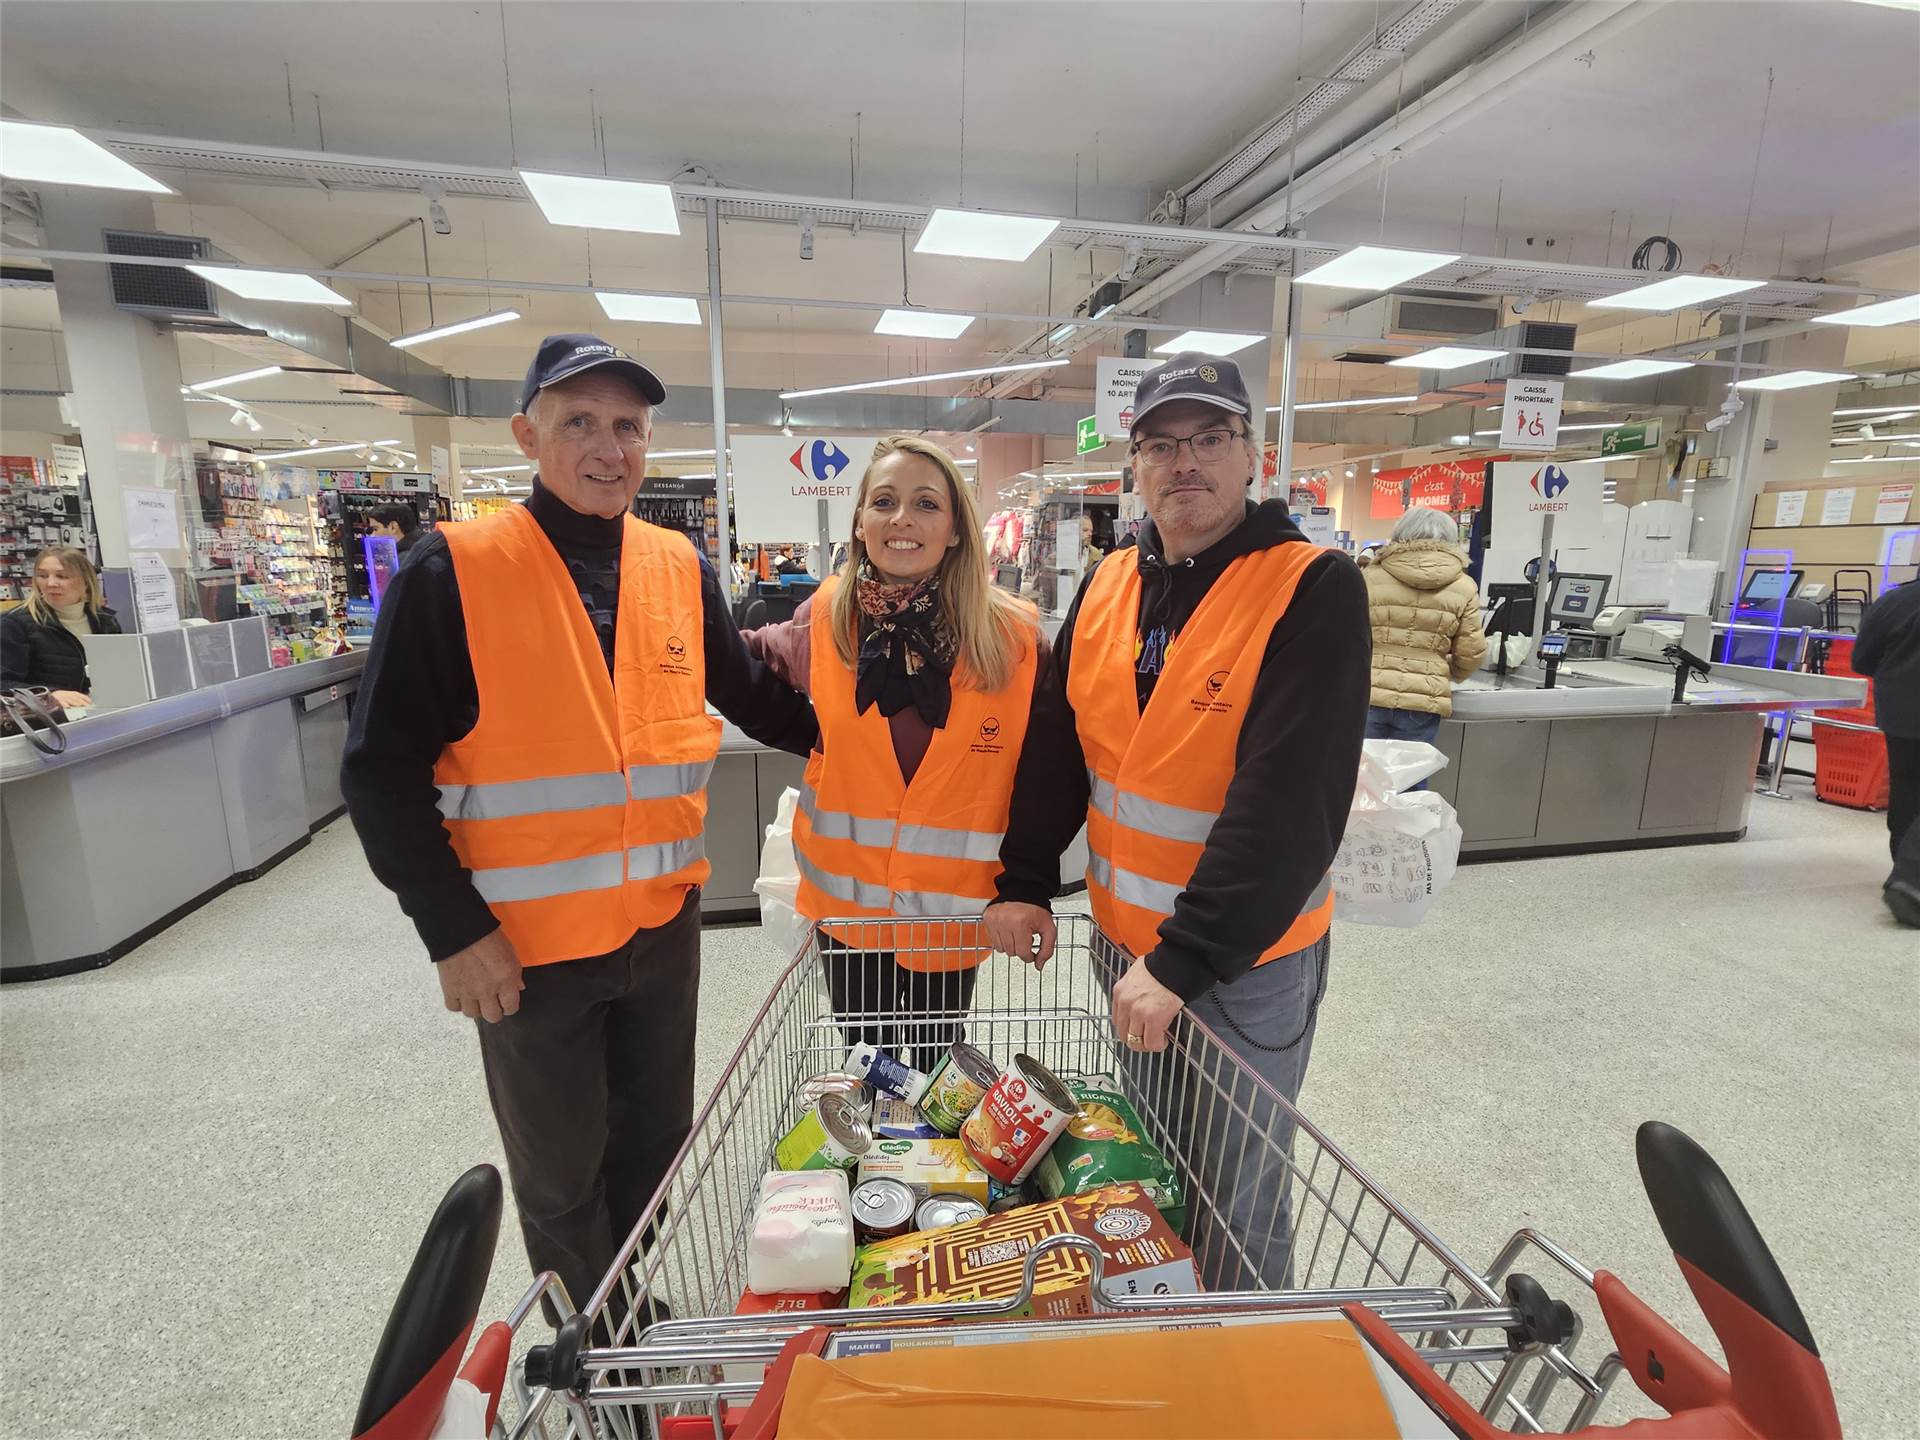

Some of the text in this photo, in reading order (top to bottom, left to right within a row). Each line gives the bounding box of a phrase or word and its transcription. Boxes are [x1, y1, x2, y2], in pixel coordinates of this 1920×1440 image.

[575, 345, 614, 355] Rotary
[1158, 366, 1197, 383] Rotary
[1107, 390, 1136, 398] 10 ARTI
[1523, 386, 1548, 394] CAISSE
[1513, 395, 1555, 404] PRIORITAIRE
[791, 486, 852, 496] LAMBERT
[1424, 481, 1444, 493] c'est
[1528, 503, 1569, 512] LAMBERT
[1426, 872, 1432, 881] DE
[1081, 1093, 1120, 1105] RIGATE
[992, 1089, 1022, 1126] RAVIOLI
[881, 1143, 911, 1152] blédina
